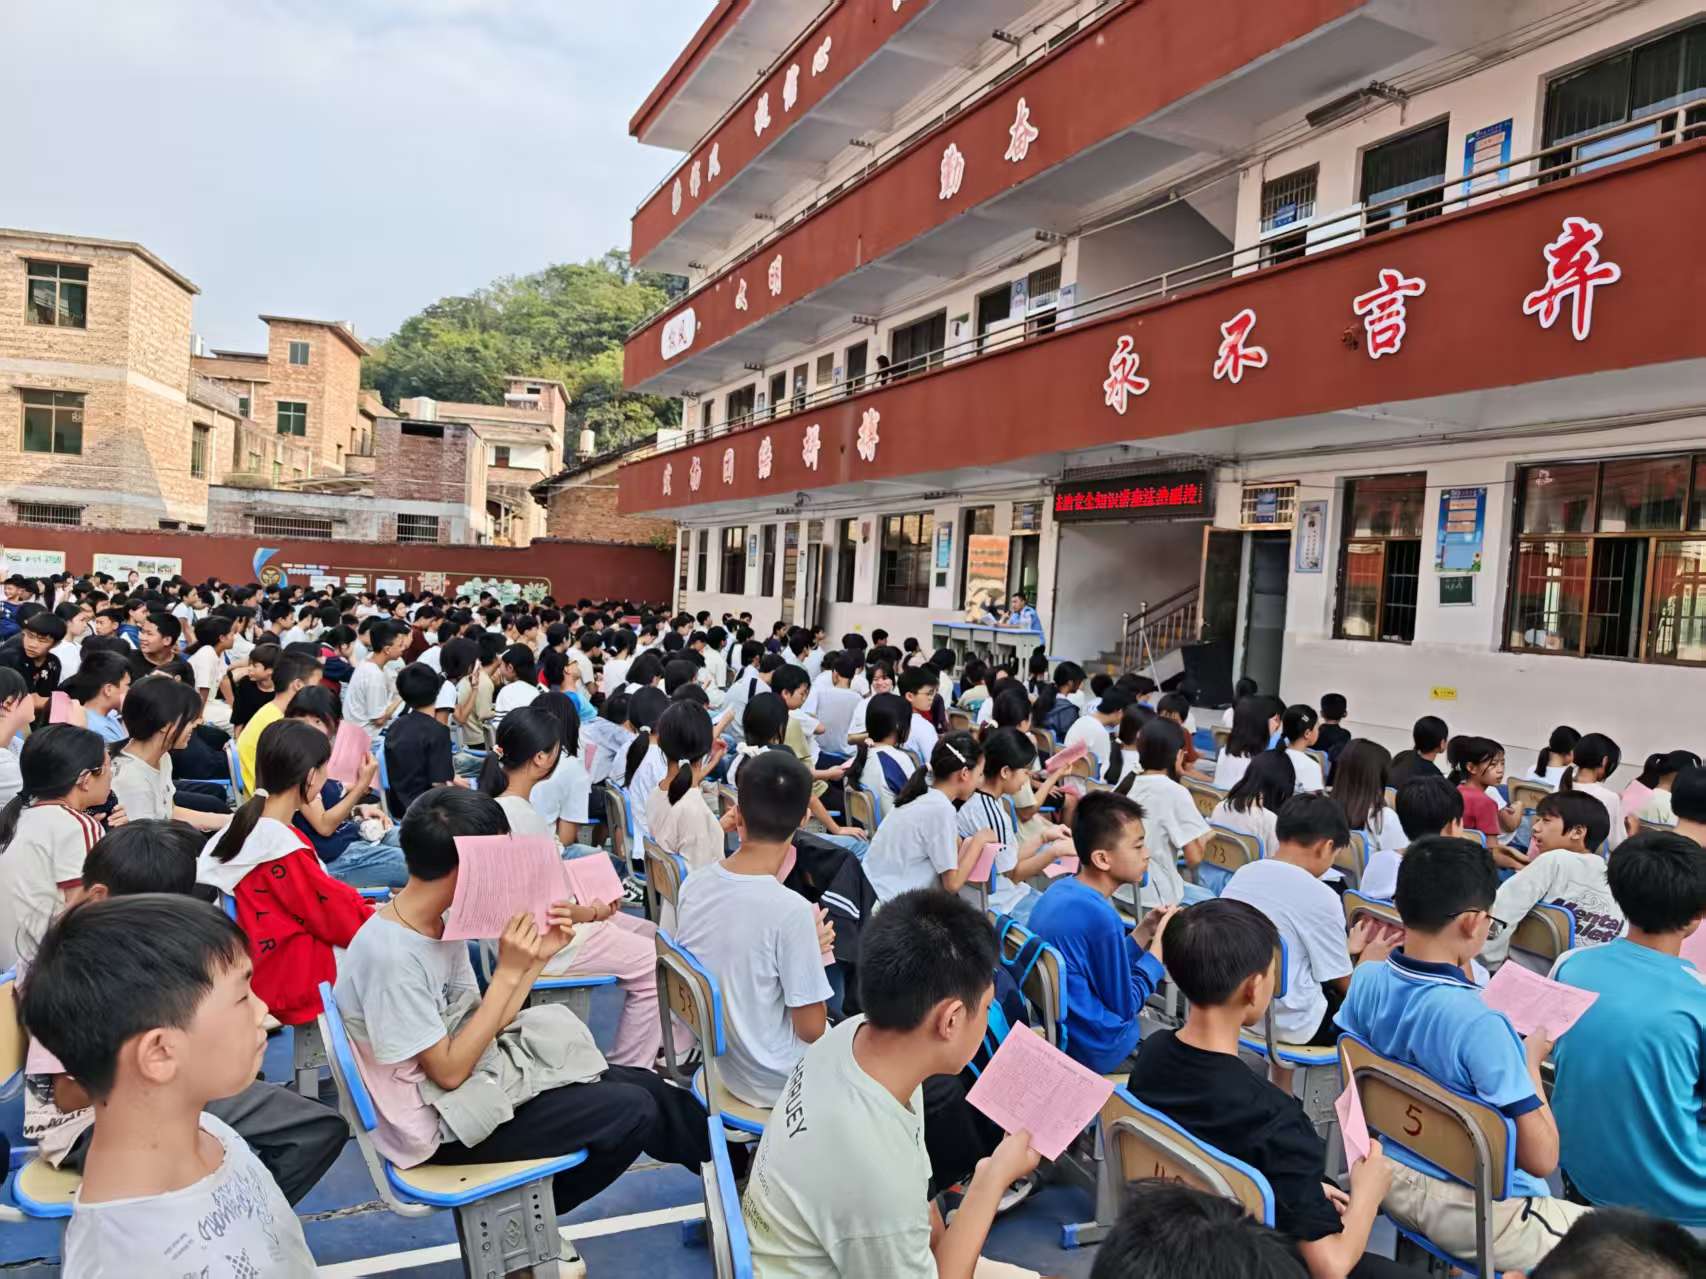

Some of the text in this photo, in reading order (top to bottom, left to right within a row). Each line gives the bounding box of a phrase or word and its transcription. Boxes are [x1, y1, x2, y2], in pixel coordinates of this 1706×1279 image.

[1103, 216, 1621, 415] 永不言弃
[1402, 1103, 1423, 1137] 5
